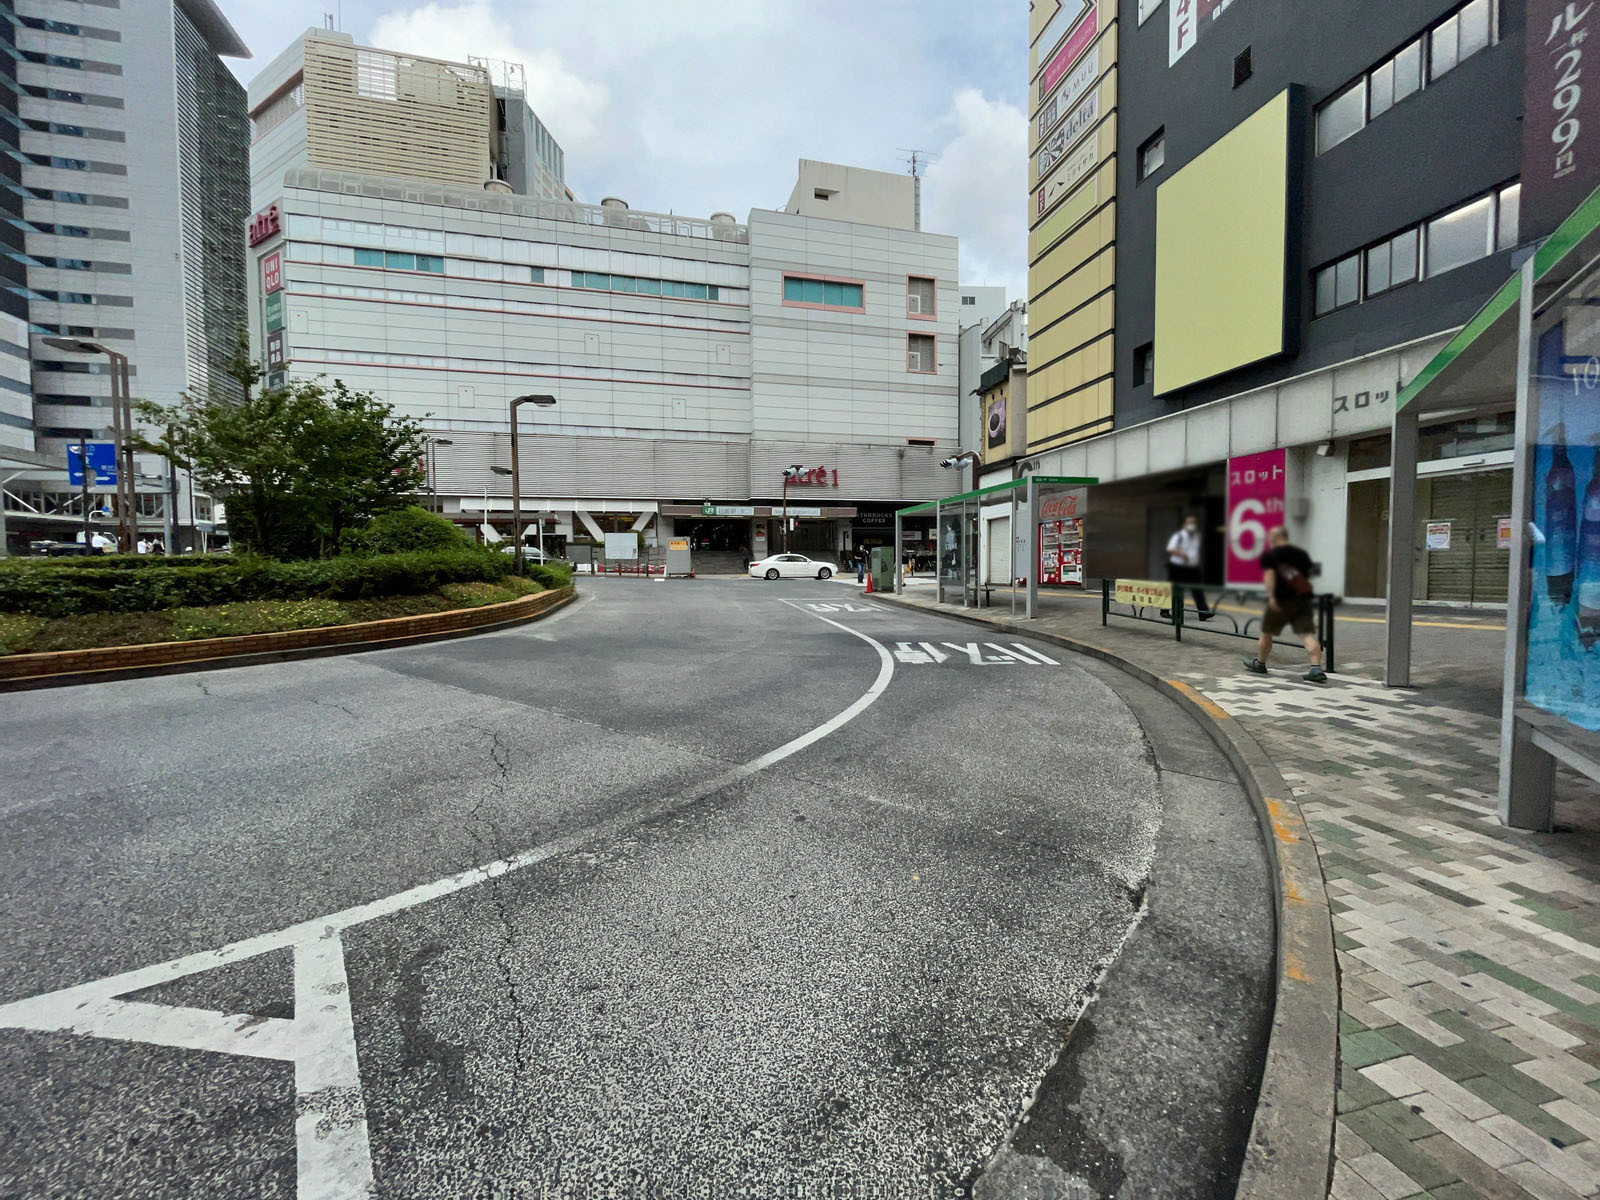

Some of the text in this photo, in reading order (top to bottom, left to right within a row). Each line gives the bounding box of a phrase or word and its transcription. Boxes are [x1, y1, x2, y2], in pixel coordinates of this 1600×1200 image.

[265, 257, 278, 274] UNI
[266, 271, 279, 289] QLO
[1231, 464, 1283, 486] スロット
[1229, 496, 1284, 561] 6th
